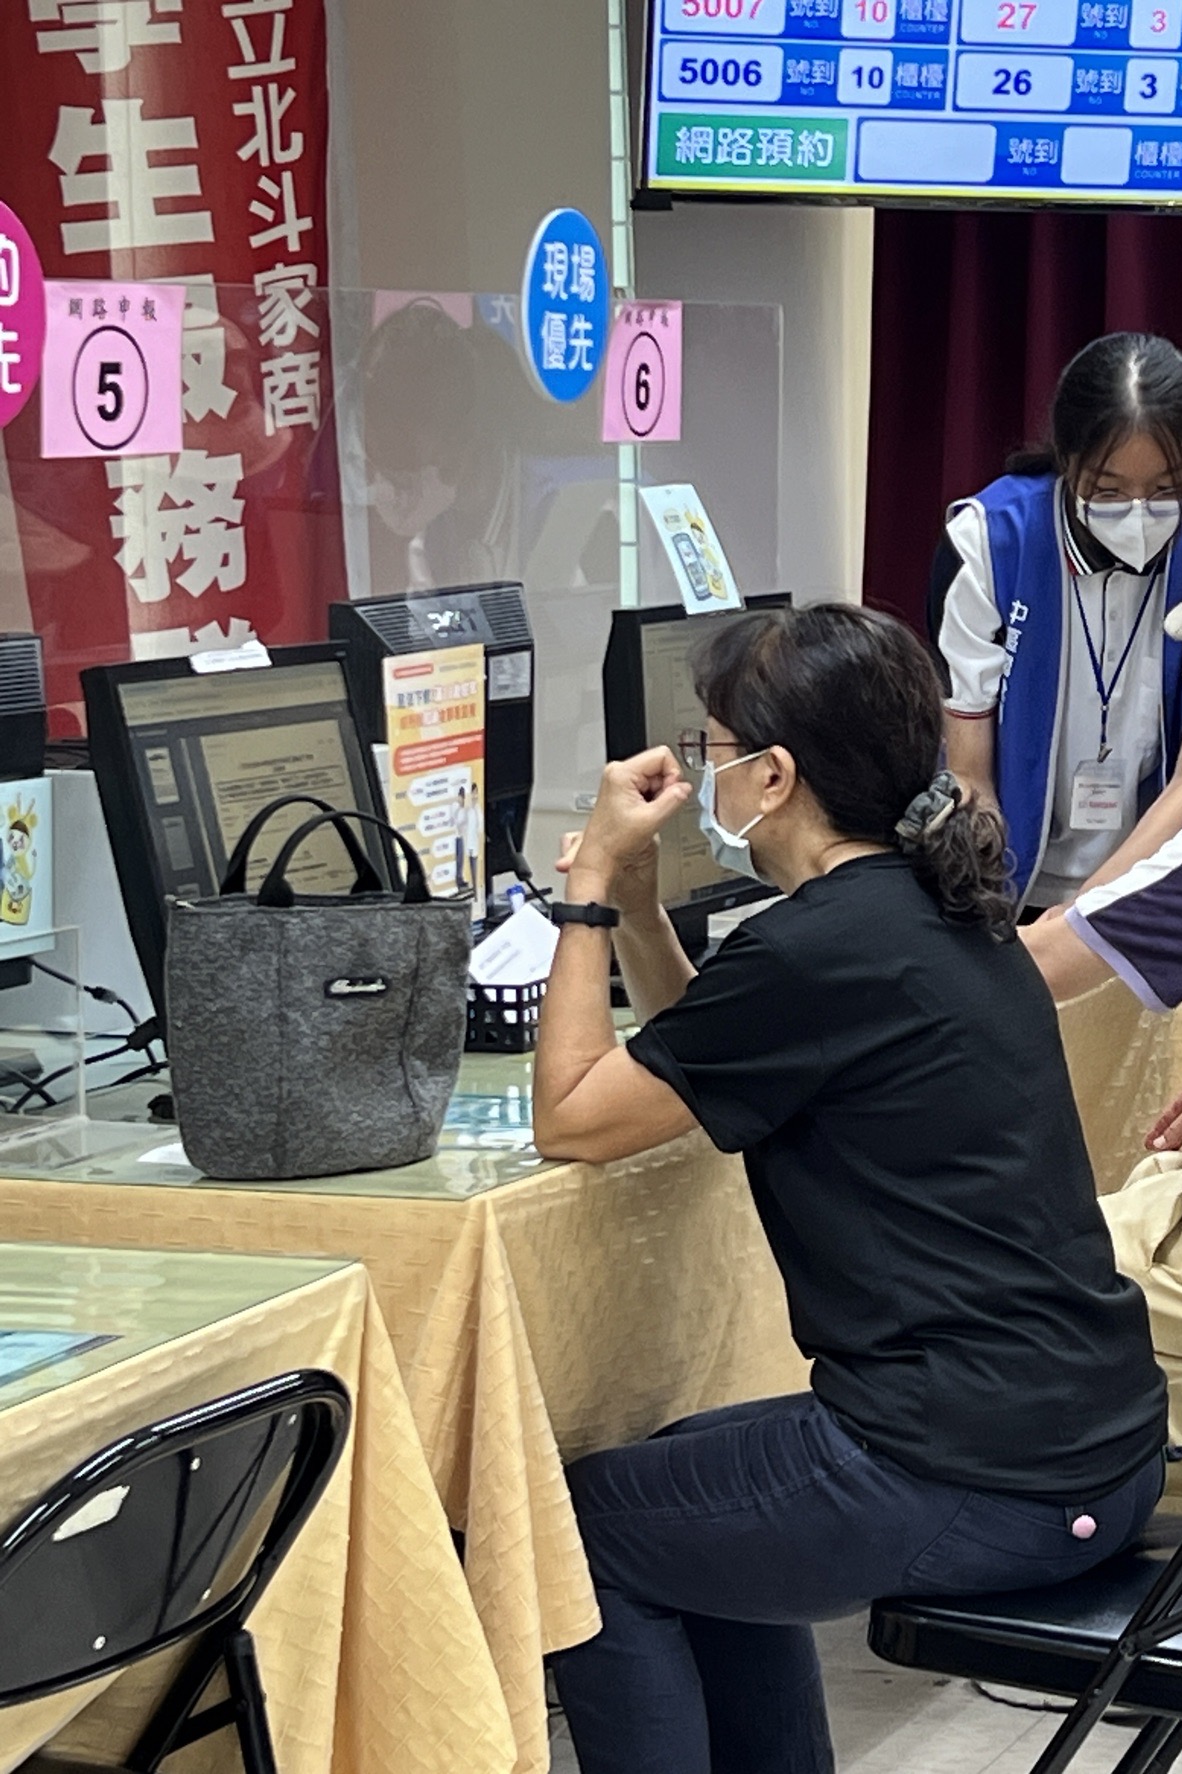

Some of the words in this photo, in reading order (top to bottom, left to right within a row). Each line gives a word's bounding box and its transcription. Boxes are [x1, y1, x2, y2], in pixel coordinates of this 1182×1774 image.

[681, 0, 764, 20] 5007
[856, 0, 888, 23] 10
[997, 3, 1037, 30] 27
[1080, 3, 1128, 29] 號到
[1150, 10, 1167, 33] 3
[900, 24, 945, 33] COUNTER
[679, 58, 763, 87] 5006
[786, 59, 836, 85] 號到
[852, 66, 885, 89] 10
[992, 69, 1032, 96] 26
[1075, 69, 1123, 94] 號到
[1139, 73, 1158, 100] 3
[895, 90, 941, 100] COUNTER
[675, 126, 834, 168] 網路預約
[1007, 138, 1060, 165] 號到
[1135, 170, 1180, 180] COUNTER
[543, 241, 595, 302] 現場
[541, 311, 594, 371] 優先
[97, 362, 123, 422] 5
[636, 363, 651, 410] 6
